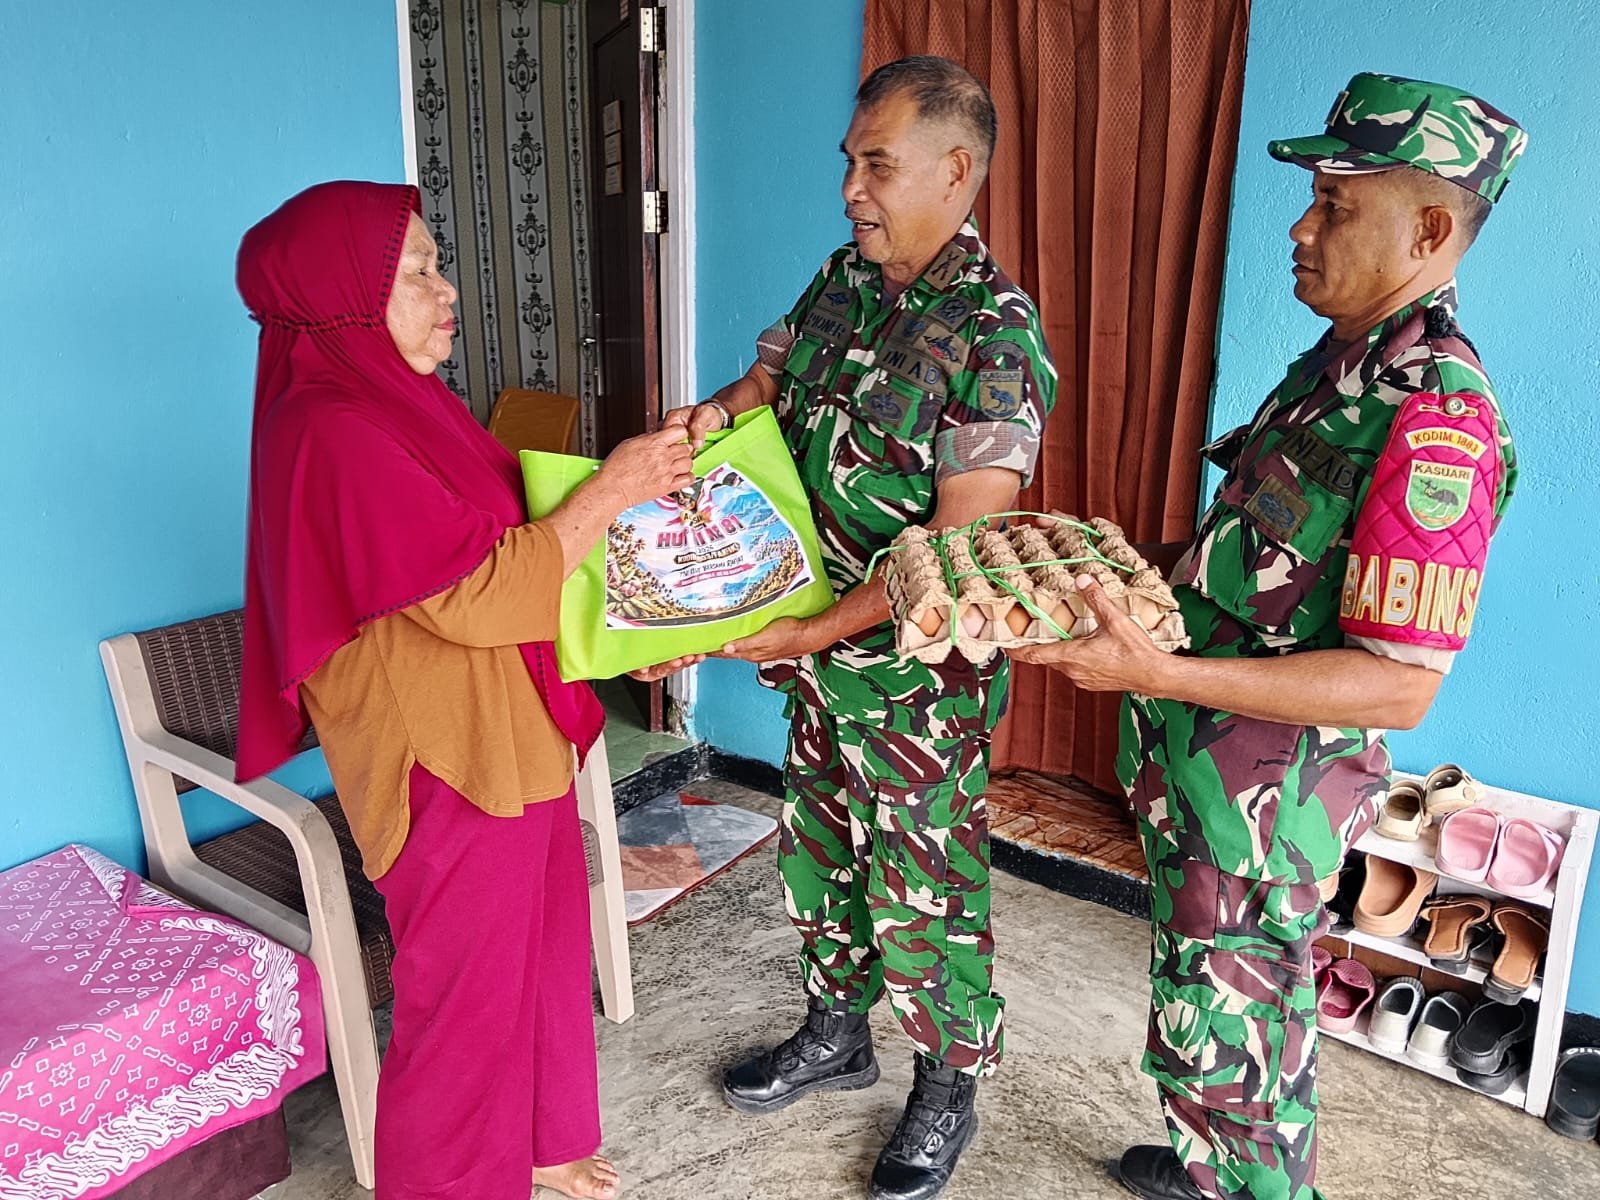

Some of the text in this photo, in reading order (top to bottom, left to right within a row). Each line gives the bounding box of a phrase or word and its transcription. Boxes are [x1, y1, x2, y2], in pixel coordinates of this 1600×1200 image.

[1413, 430, 1454, 445] KODIM
[1414, 463, 1471, 480] KASUARI
[720, 513, 745, 534] 81
[1340, 554, 1484, 638] BABINS
